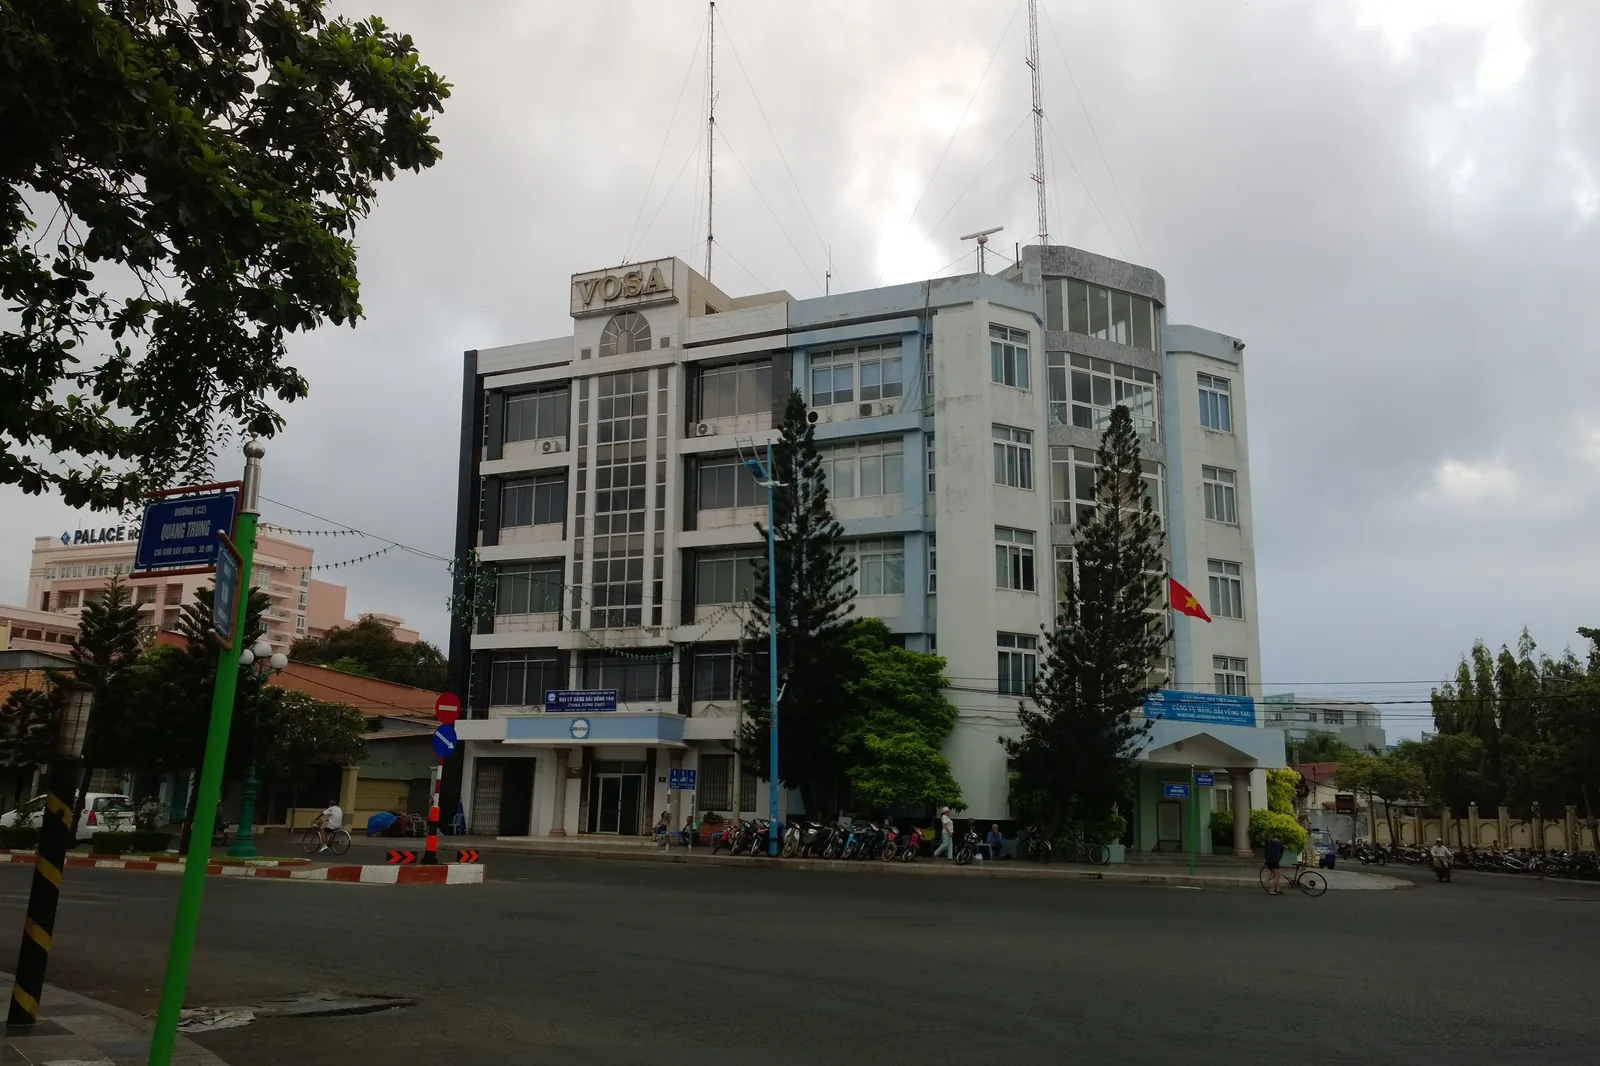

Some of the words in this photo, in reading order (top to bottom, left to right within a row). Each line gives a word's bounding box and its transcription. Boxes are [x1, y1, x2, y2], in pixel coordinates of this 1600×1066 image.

[572, 266, 670, 305] VOSA
[73, 526, 125, 545] PALACE
[161, 522, 186, 541] QUANG
[187, 520, 211, 538] TRUNG
